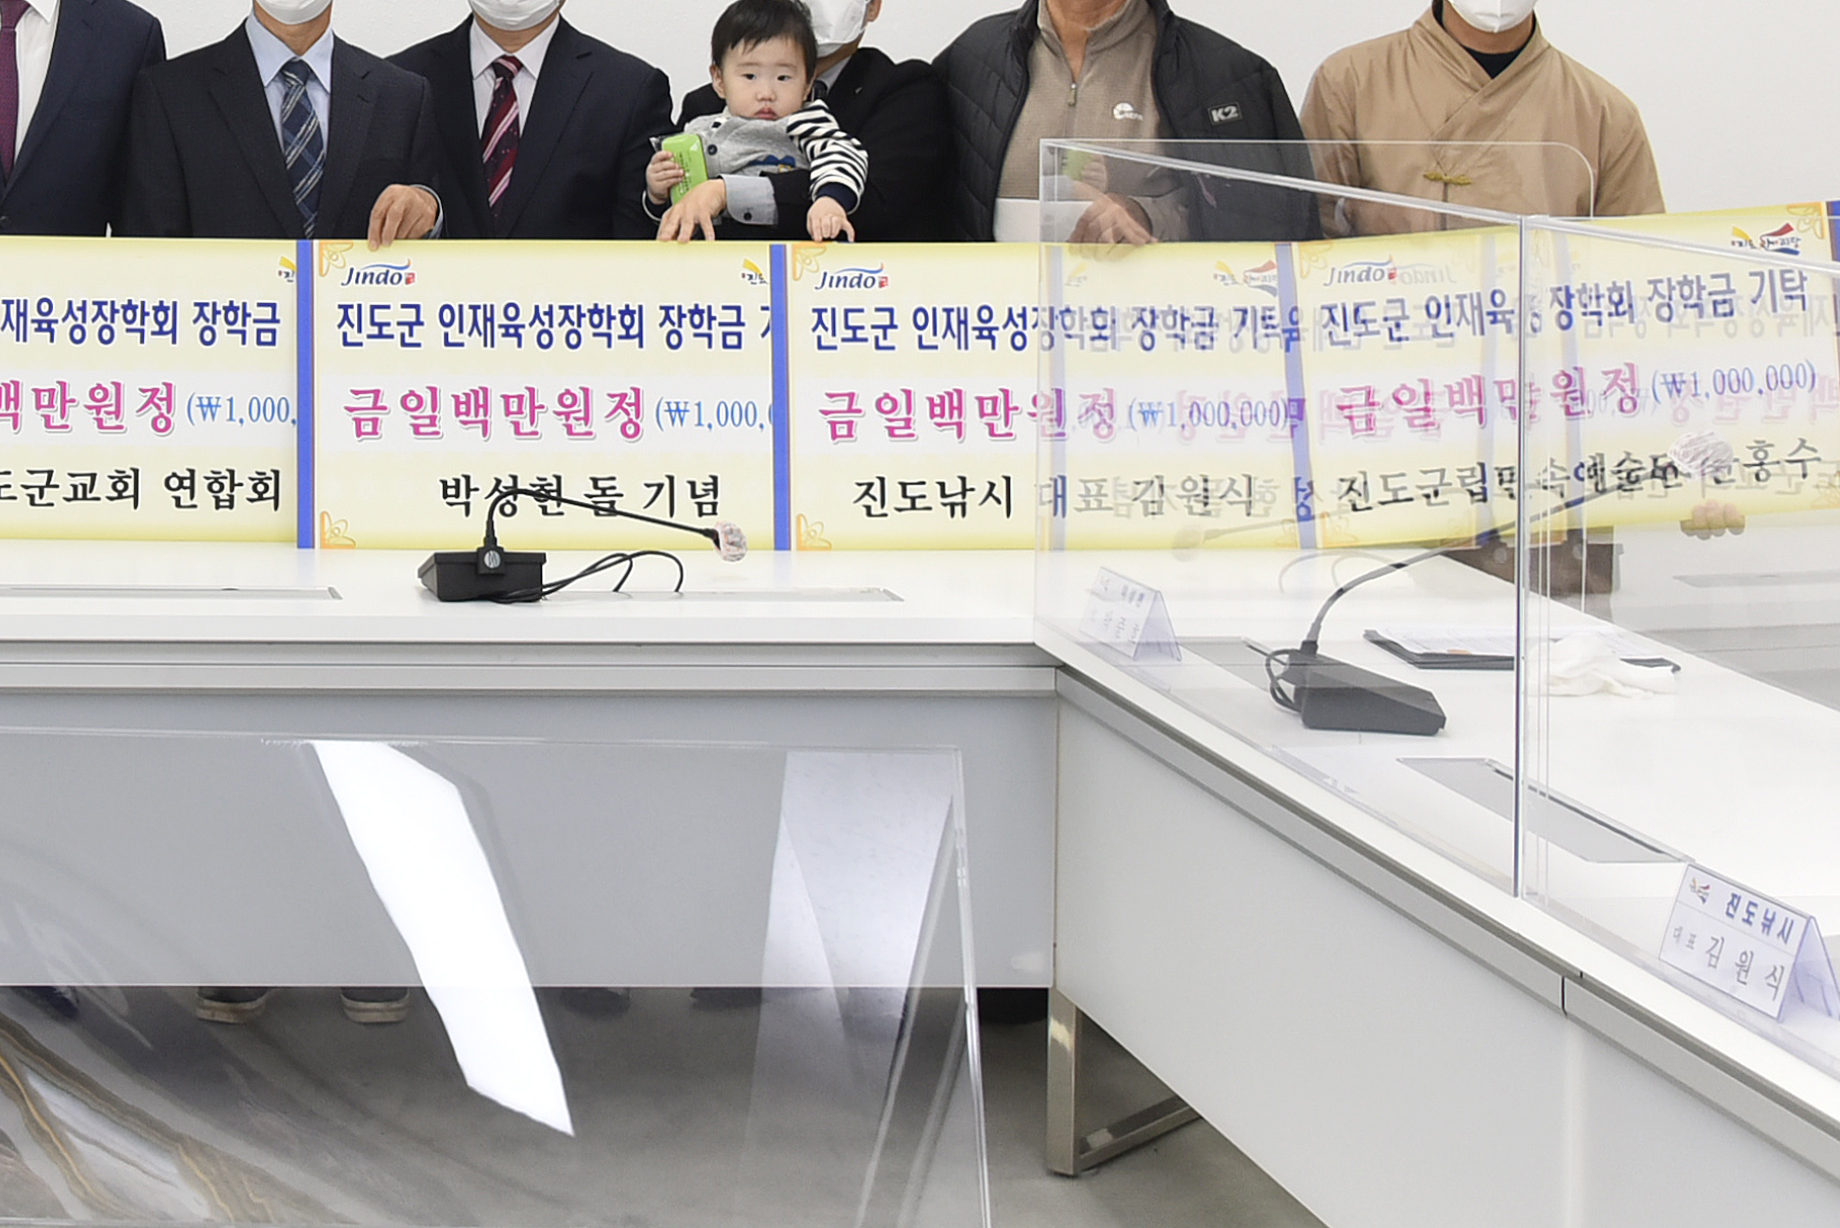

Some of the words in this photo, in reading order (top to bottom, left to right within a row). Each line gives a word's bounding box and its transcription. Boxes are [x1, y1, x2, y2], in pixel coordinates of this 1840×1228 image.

[1211, 105, 1239, 122] K2
[341, 267, 402, 286] Jindo
[814, 272, 875, 290] Jindo
[1323, 266, 1384, 287] Jindo
[193, 300, 280, 346] 장학금
[337, 303, 424, 348] 진도군
[439, 302, 643, 350] 인재육성장학회
[659, 303, 745, 350] 장학금
[812, 307, 898, 350] 진도군
[912, 305, 1117, 351] 인재육성장학회
[1131, 305, 1215, 351] 장학금
[1322, 299, 1410, 346] 진도군
[1646, 273, 1737, 322] 장학금
[1749, 268, 1808, 313] 기탁
[1651, 359, 1816, 403] (₩1,000,000)
[344, 386, 642, 442] 금일백만원정
[655, 397, 772, 432] (₩1,000,
[819, 387, 1116, 440] 금일백만원정
[1703, 436, 1823, 485] 홍수
[164, 468, 280, 511] 연합회
[440, 473, 565, 518] 박성현
[643, 474, 719, 519] 기념
[853, 475, 1012, 520] 진도낚시
[1039, 474, 1114, 518] 대표
[1131, 474, 1253, 517] 김원식
[1725, 892, 1794, 944] 진도낚시
